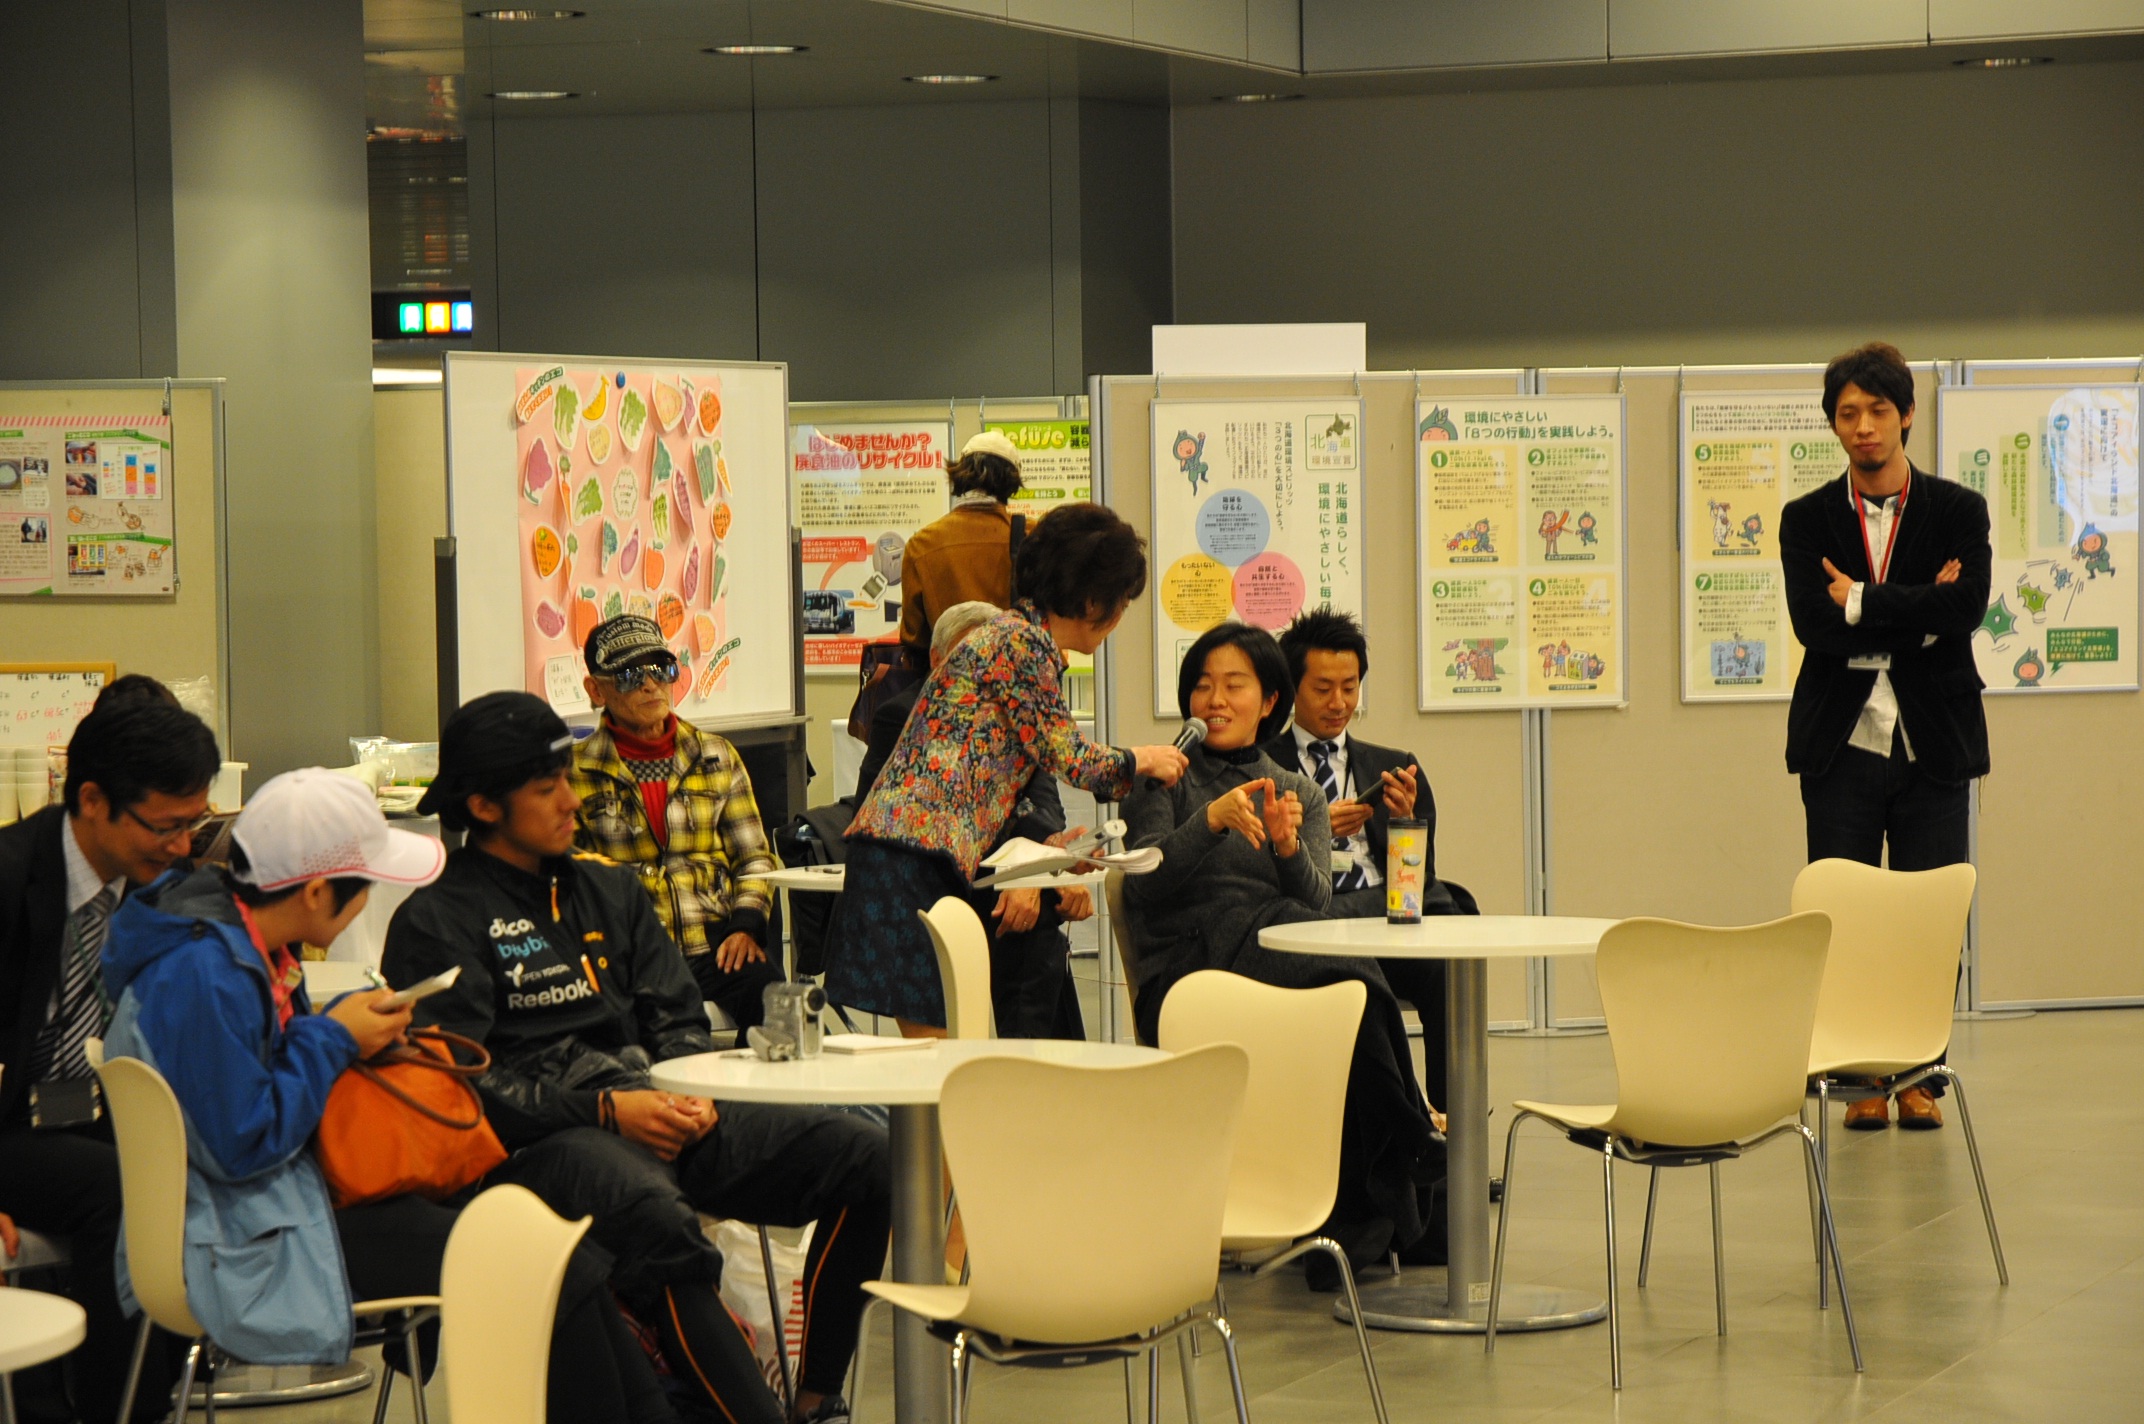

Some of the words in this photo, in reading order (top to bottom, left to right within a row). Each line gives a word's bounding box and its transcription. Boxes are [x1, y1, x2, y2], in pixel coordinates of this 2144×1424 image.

[1464, 411, 1548, 424] 環境にやさしい
[808, 431, 932, 452] はじめませんか?
[1465, 425, 1614, 440] 「8つの行動」を実践しよう。
[1335, 481, 1349, 576] 北海道らしく、
[508, 978, 593, 1010] Reebok
